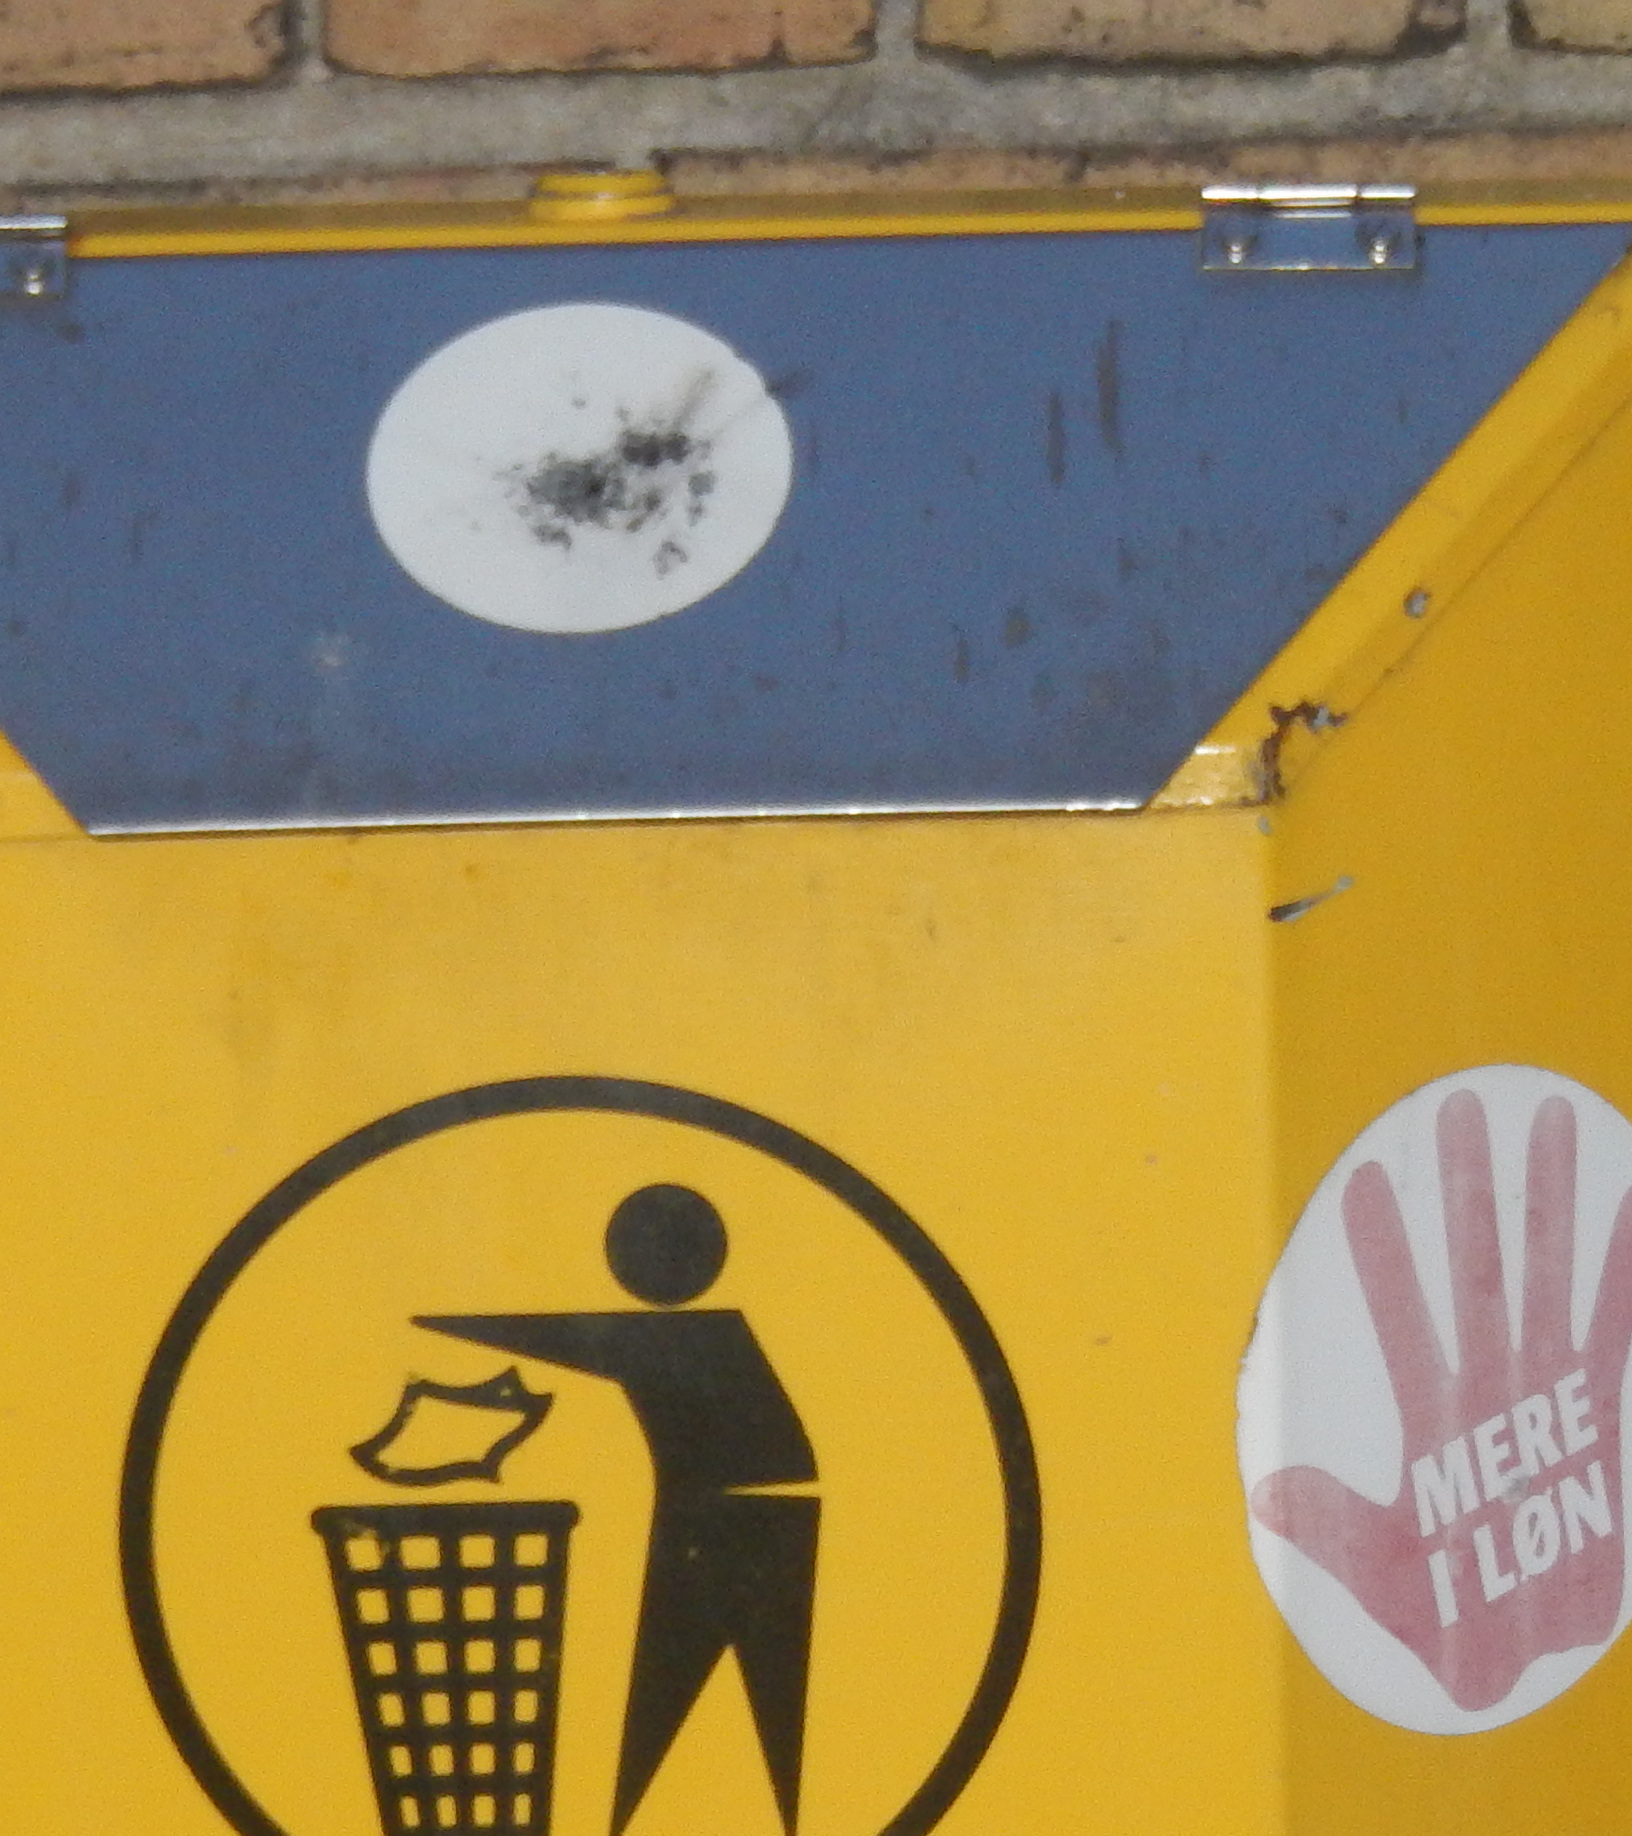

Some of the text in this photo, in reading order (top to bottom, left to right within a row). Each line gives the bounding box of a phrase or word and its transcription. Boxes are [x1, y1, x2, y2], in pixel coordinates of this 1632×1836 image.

[1411, 1369, 1599, 1538] MERE
[1427, 1461, 1613, 1628] I LØN
